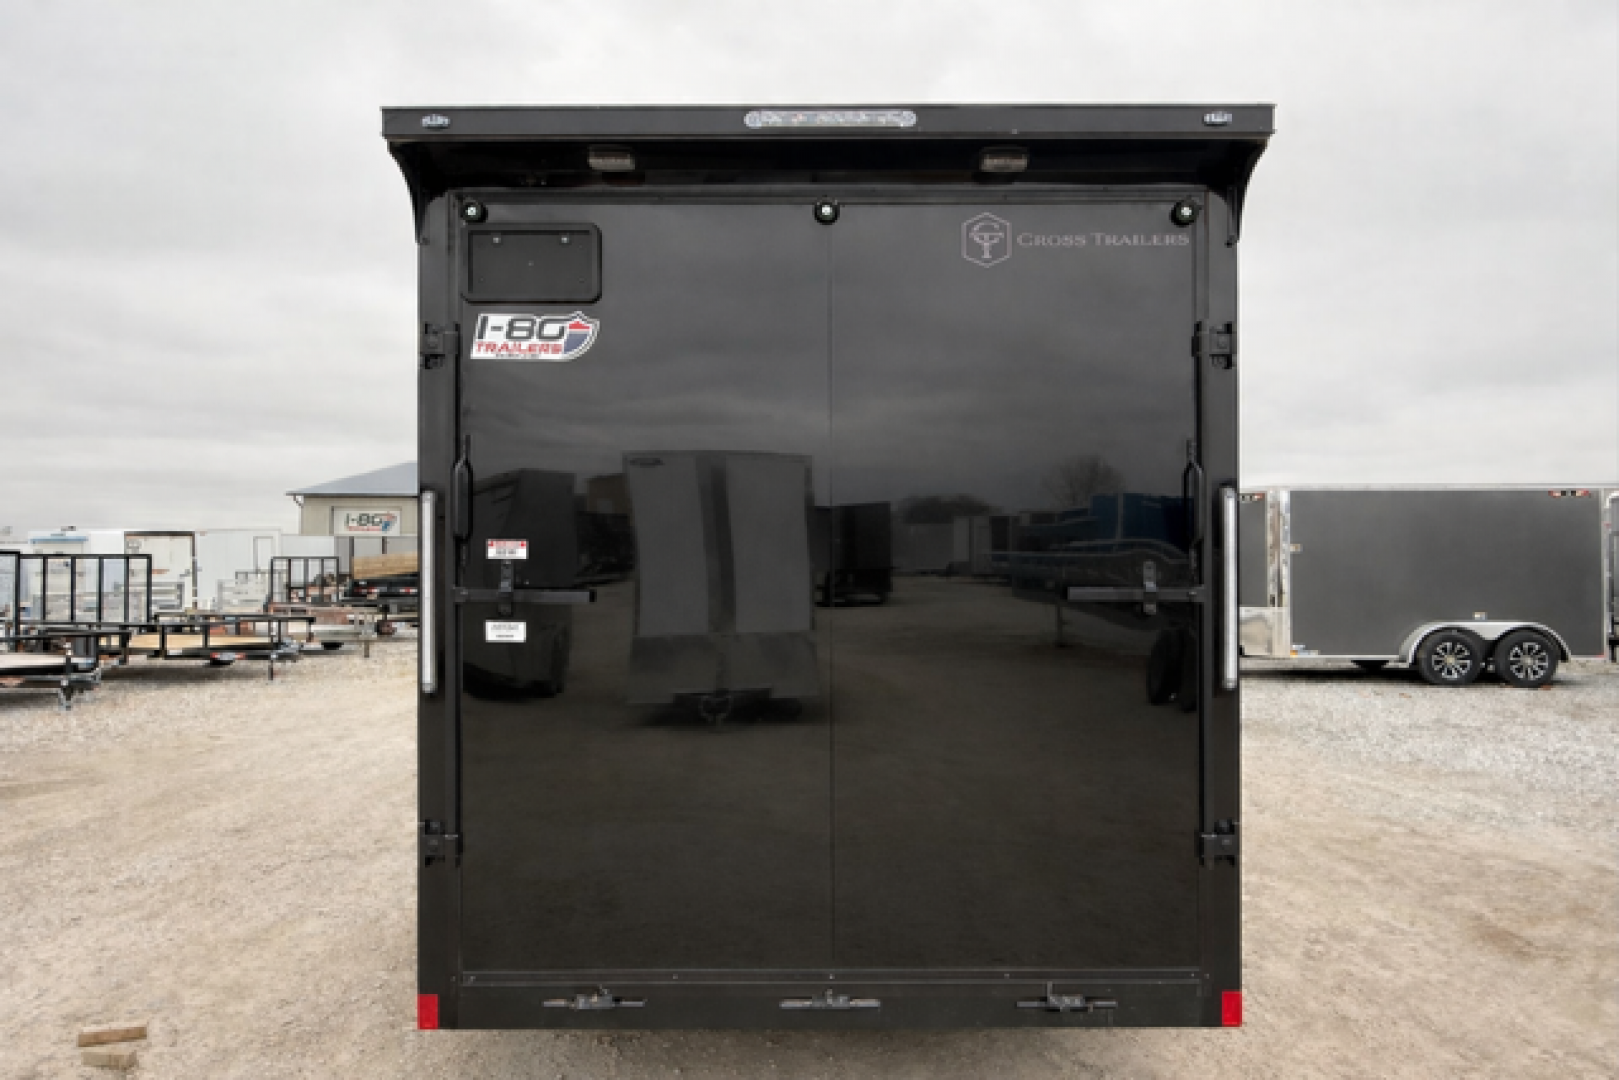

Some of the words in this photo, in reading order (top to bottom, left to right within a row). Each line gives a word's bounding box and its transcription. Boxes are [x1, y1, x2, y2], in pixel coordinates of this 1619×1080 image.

[1016, 232, 1087, 248] CROSS
[1090, 232, 1190, 247] TRAILERS
[477, 315, 571, 341] I-80
[475, 341, 563, 354] TRAILERS
